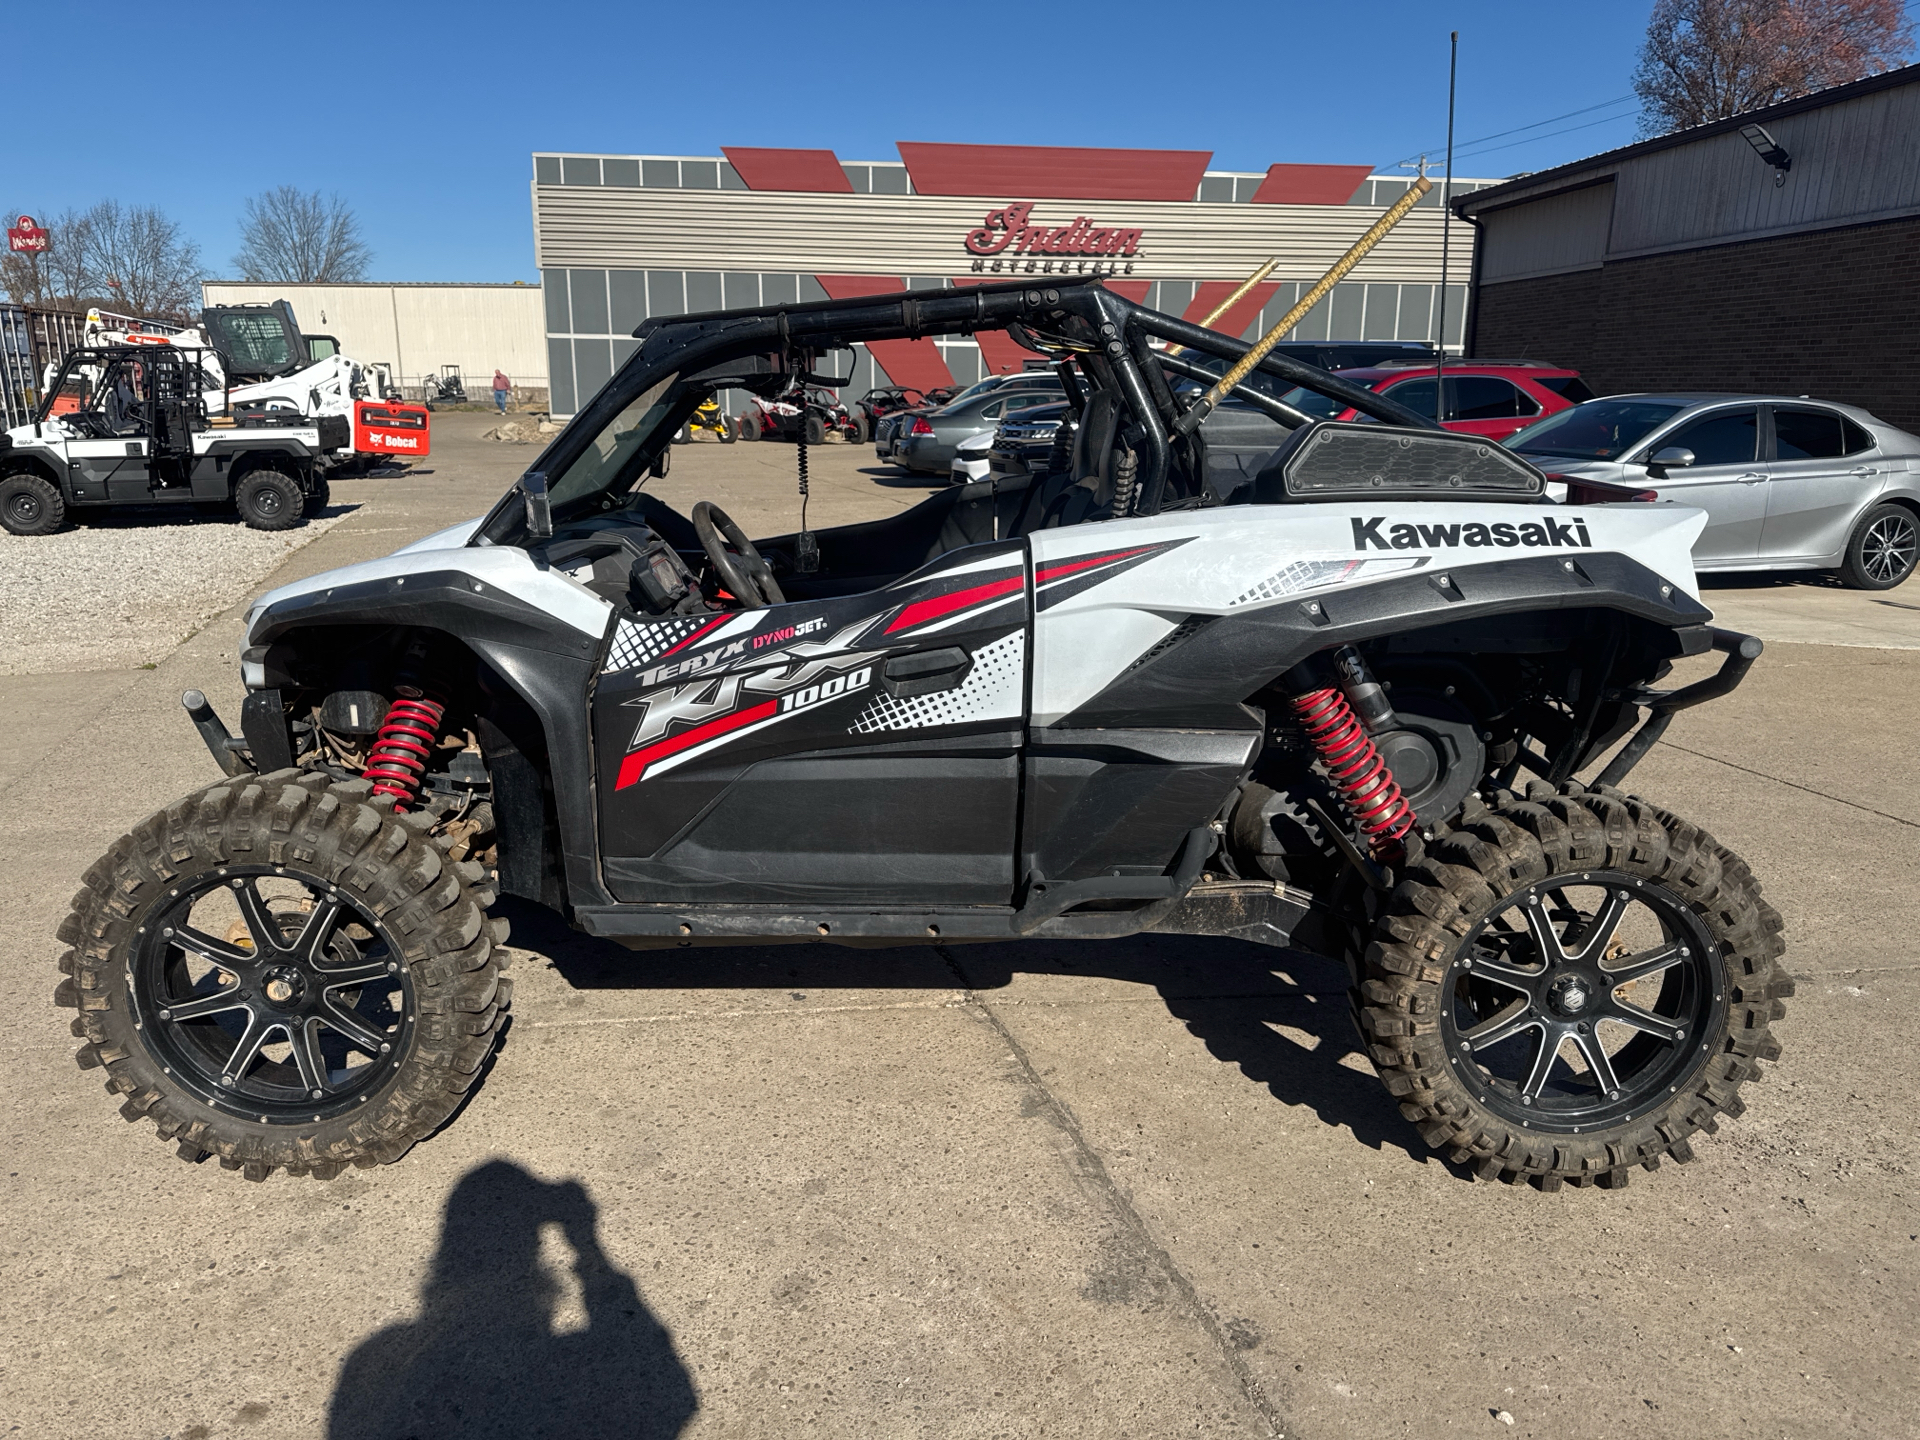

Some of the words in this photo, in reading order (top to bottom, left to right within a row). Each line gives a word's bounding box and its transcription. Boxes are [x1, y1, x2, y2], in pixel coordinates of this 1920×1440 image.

[965, 202, 1144, 255] Indian
[971, 259, 1134, 275] MOTORCYCLE
[385, 435, 418, 449] Bobcat
[1351, 516, 1592, 551] Kawasaki
[635, 637, 747, 683] TERYX
[781, 667, 872, 713] 1000
